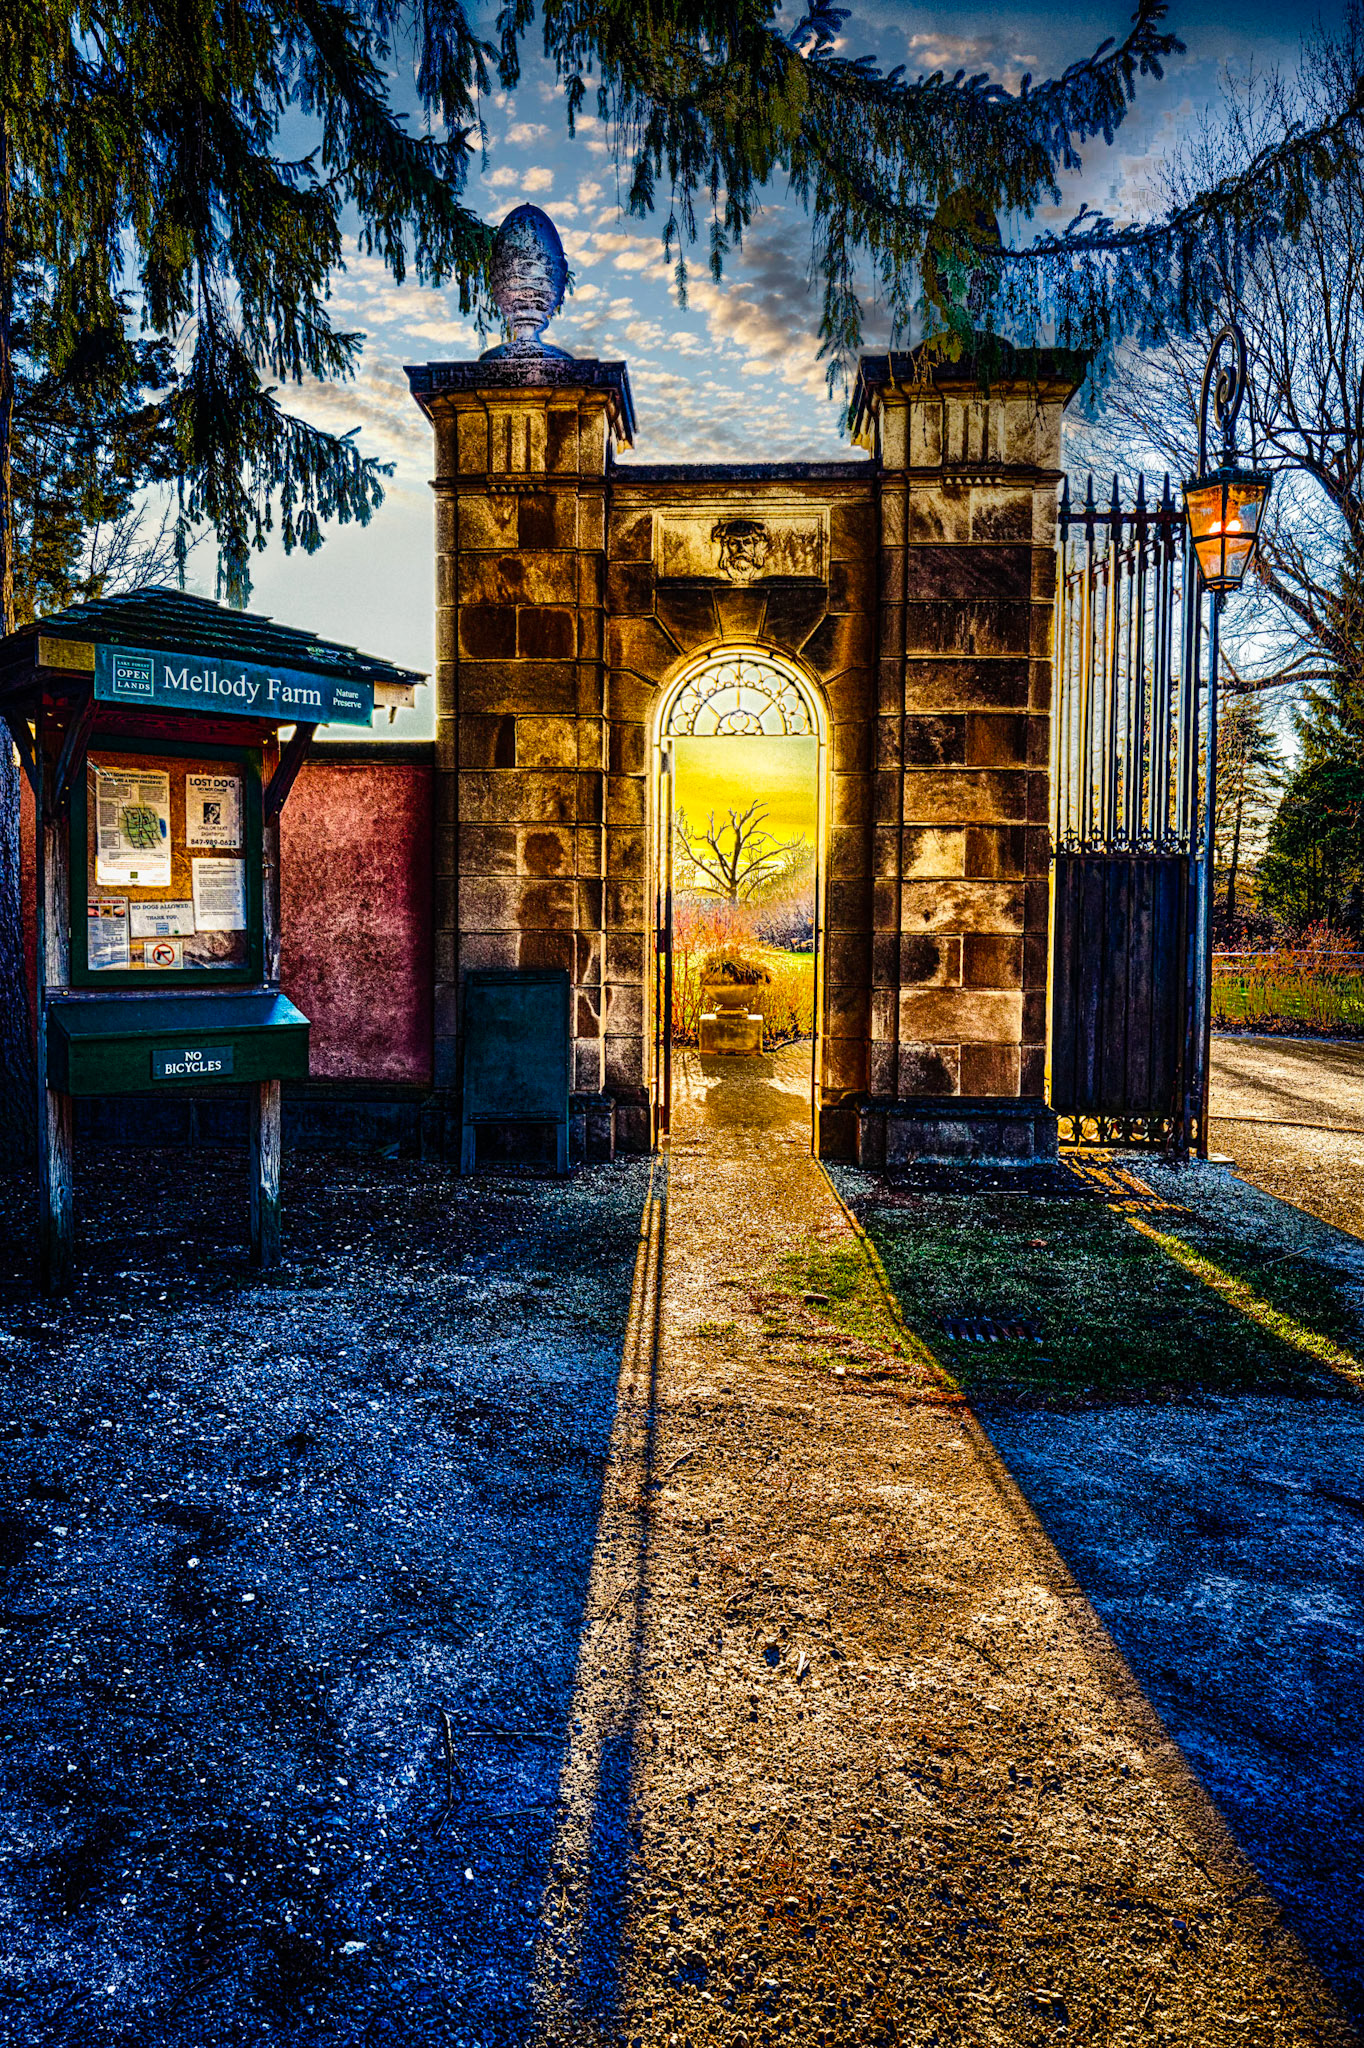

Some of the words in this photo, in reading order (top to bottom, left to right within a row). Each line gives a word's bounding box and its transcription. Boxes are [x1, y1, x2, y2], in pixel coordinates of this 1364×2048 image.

[117, 669, 149, 680] OPEN
[117, 681, 151, 690] LANDS
[163, 665, 260, 704] Mellody
[267, 678, 321, 706] Farm
[335, 688, 359, 699] Nature
[333, 697, 362, 709] Preserve
[190, 778, 211, 787] LOST
[214, 779, 235, 788] DOG
[185, 1051, 202, 1062] NO
[165, 1060, 222, 1075] BICYCLES
